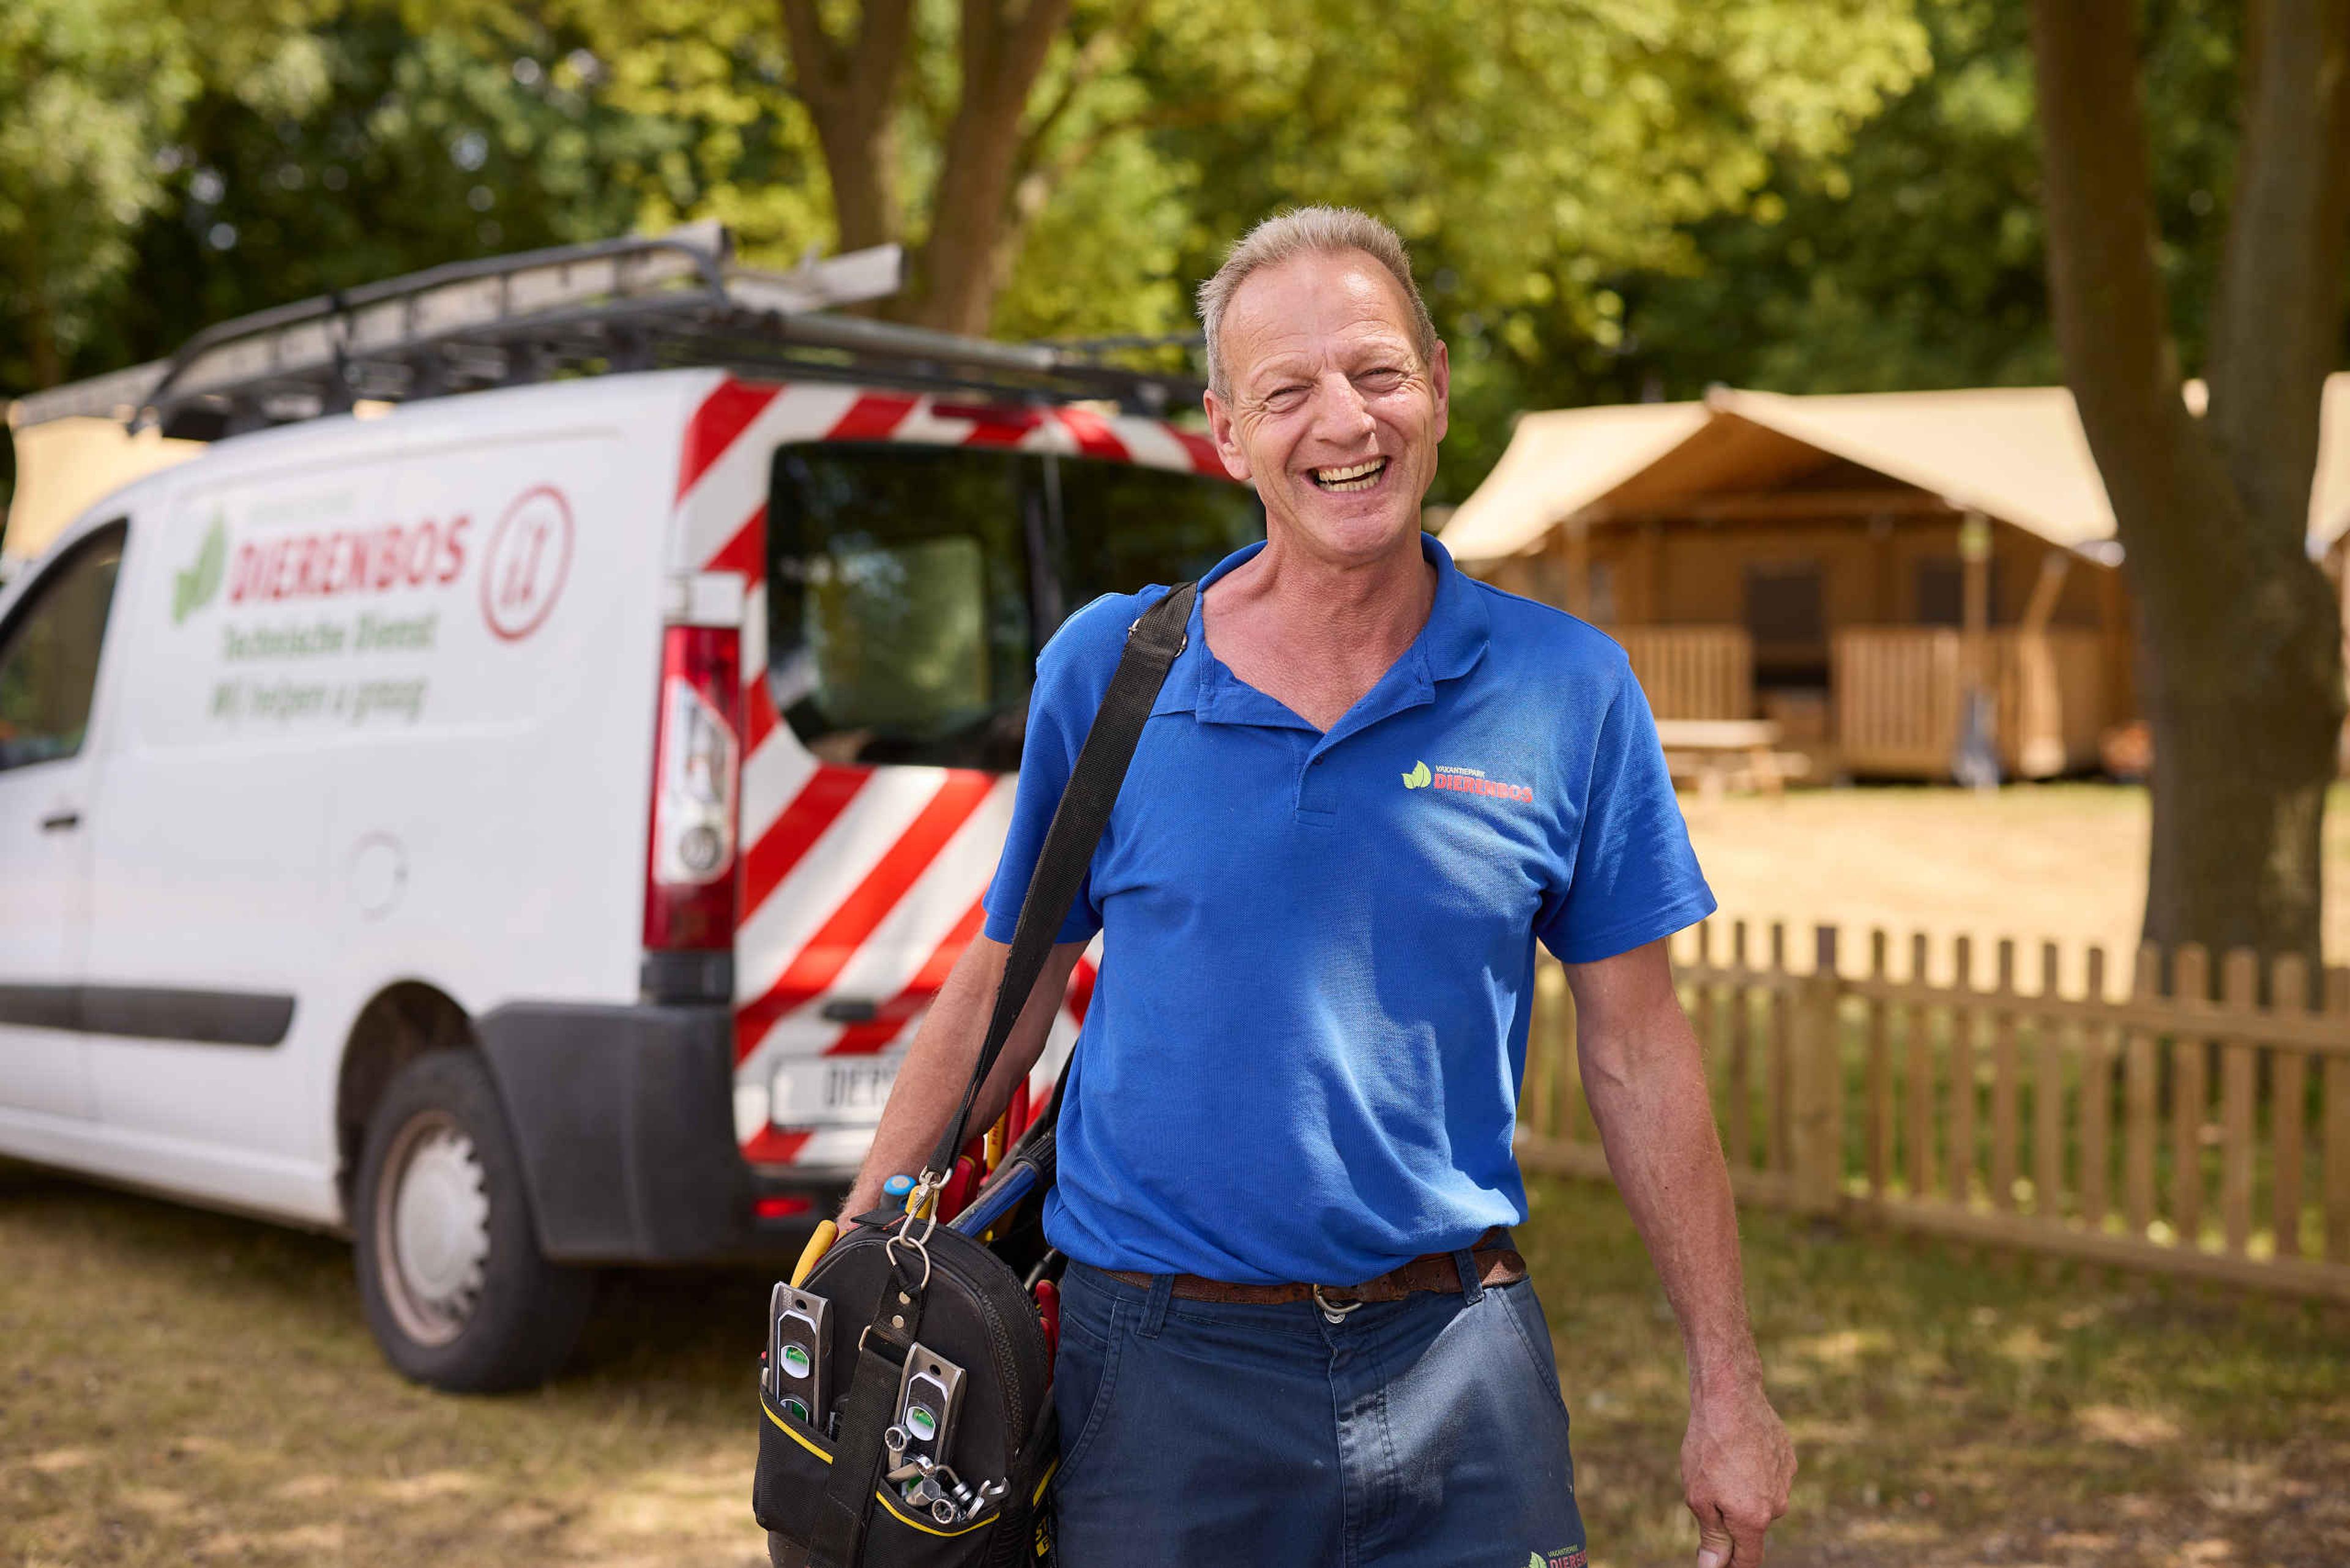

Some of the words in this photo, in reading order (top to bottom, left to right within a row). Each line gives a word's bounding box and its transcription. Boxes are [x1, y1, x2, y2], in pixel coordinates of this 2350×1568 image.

[230, 515, 474, 606] DIERENBOS
[356, 610, 438, 652] Dienst
[1434, 773, 1532, 804] DIERENBOS
[1435, 764, 1485, 778] VAKANTIEPARK
